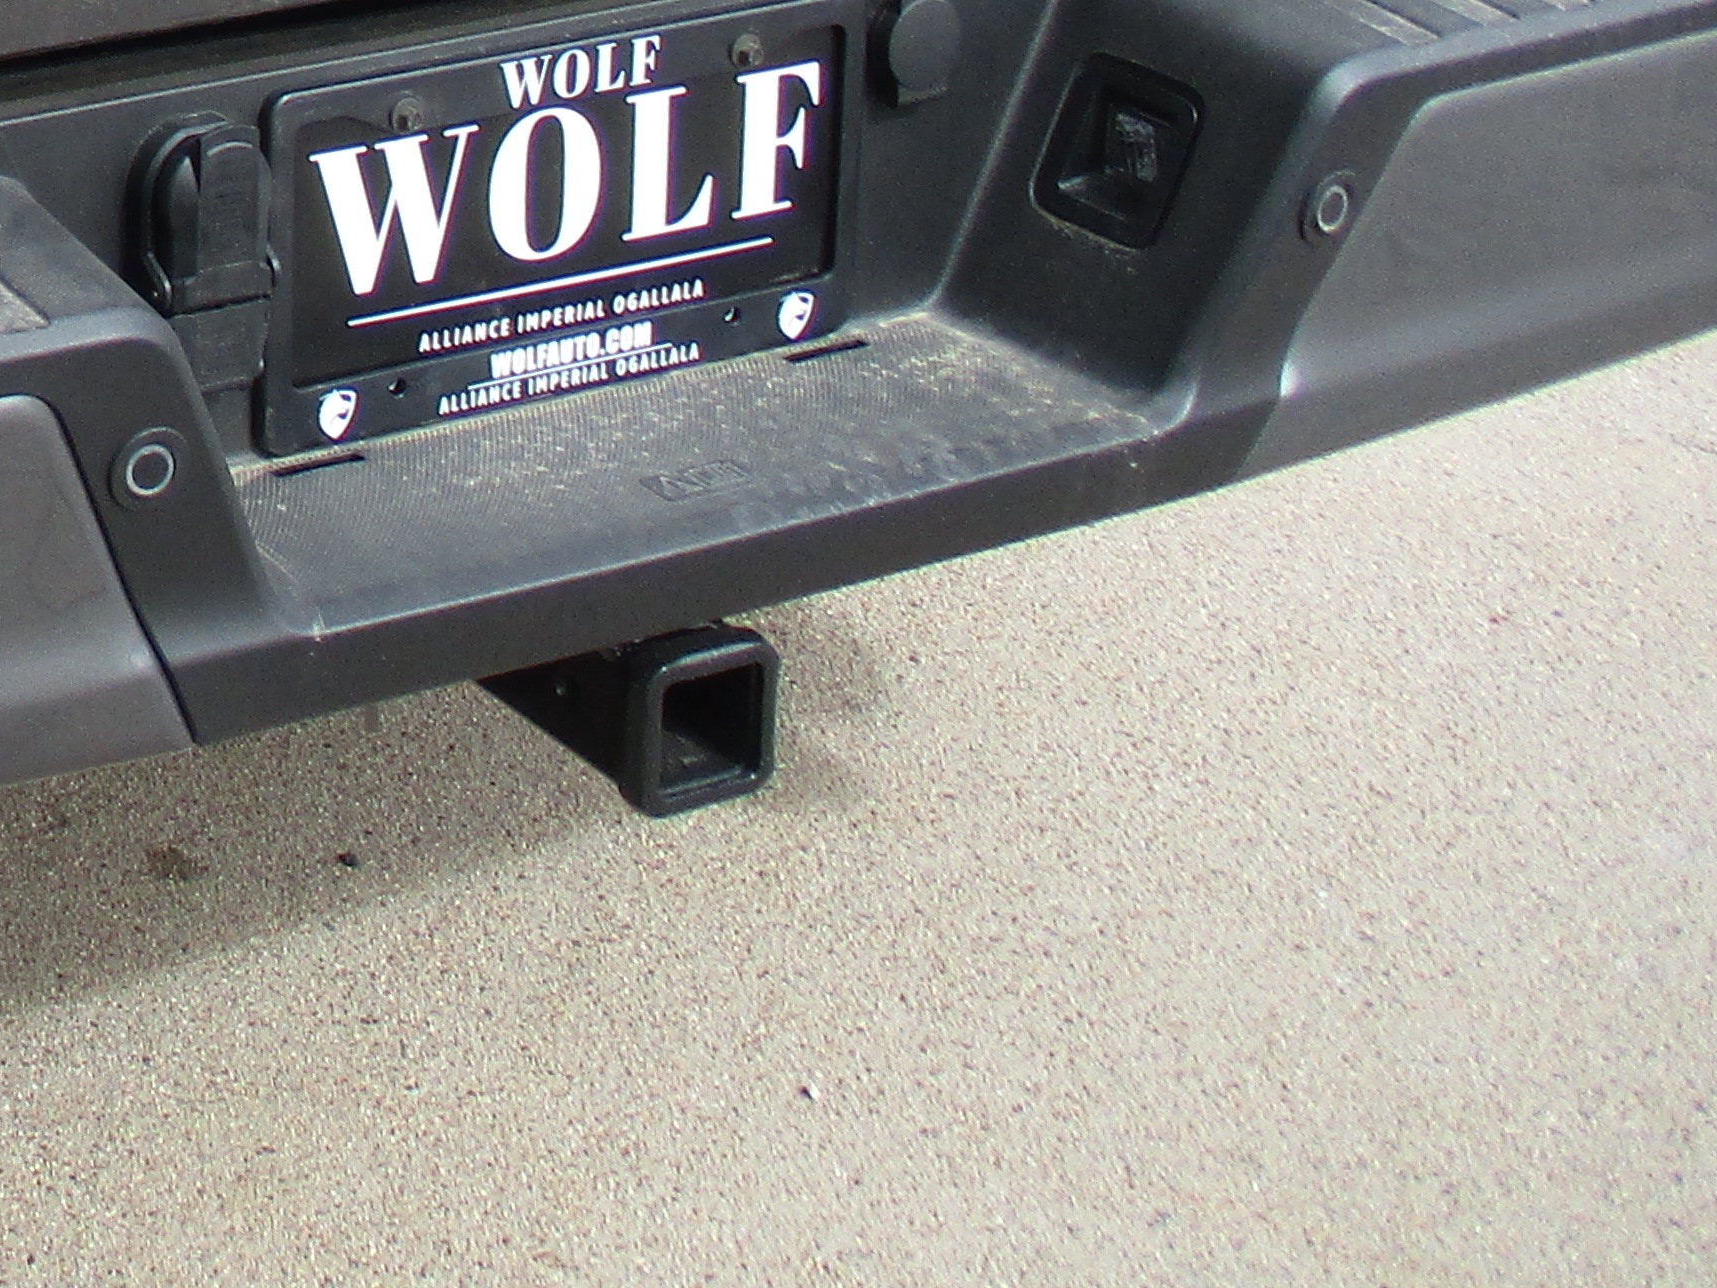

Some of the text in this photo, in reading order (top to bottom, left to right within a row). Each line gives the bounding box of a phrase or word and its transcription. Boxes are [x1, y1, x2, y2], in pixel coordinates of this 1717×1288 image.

[500, 35, 662, 108] WOLF
[309, 61, 822, 295] WOLF
[418, 278, 705, 353] ALLIANCE IMPERIAL OGALLALA
[490, 321, 653, 379] WOLFAUTO.COM
[438, 342, 700, 415] ALLIANCE IMPERIAL OGALLALA
